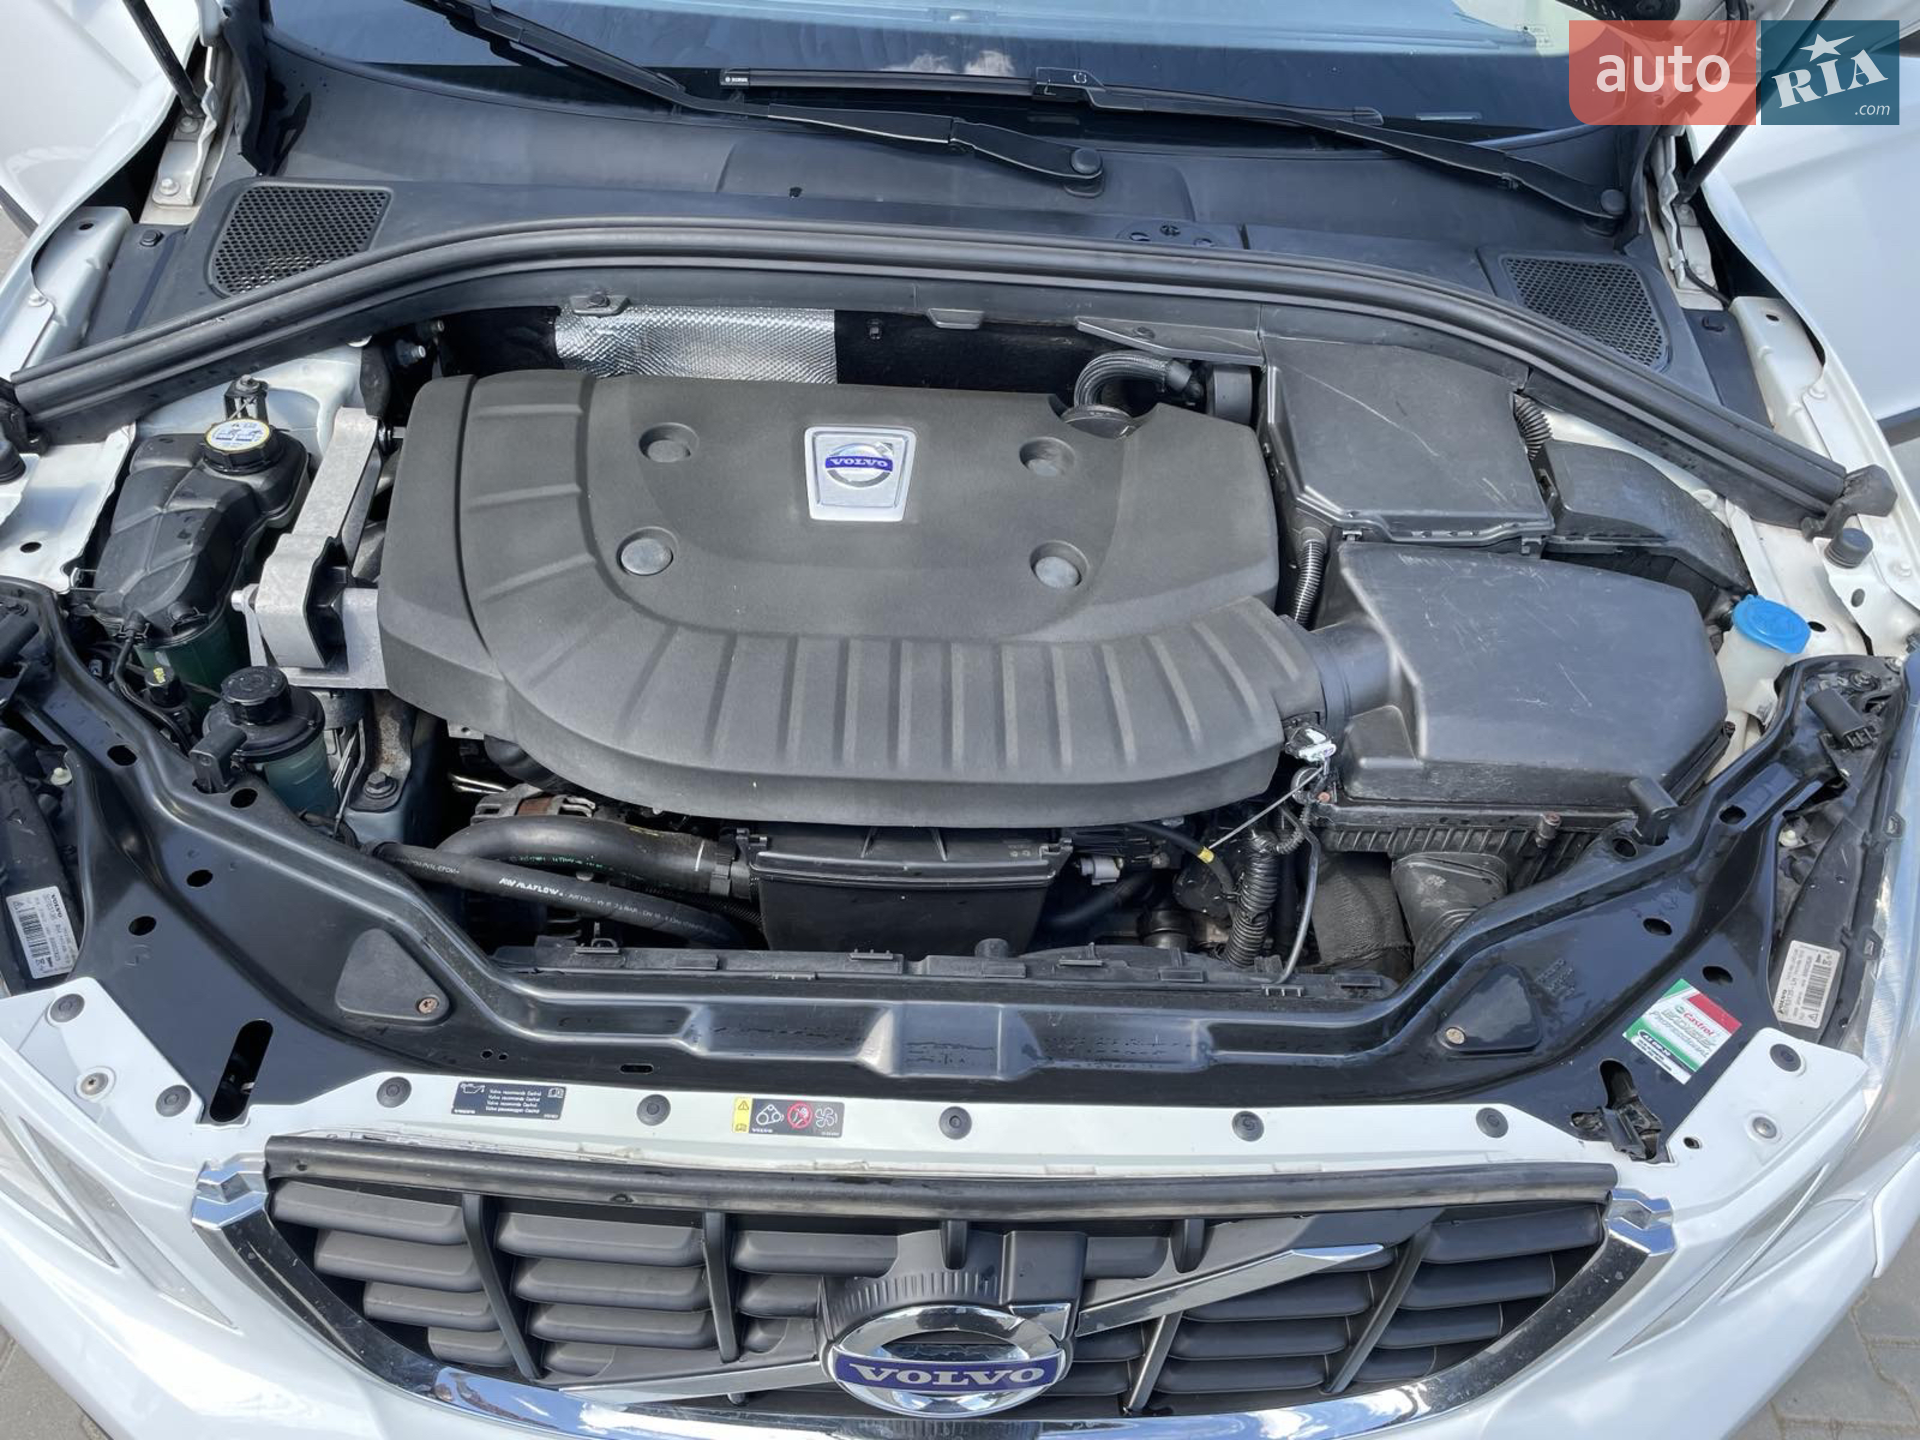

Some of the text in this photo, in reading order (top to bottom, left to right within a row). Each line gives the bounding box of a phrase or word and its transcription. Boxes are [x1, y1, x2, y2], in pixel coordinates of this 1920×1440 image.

[830, 458, 888, 466] VOLVO
[1683, 1011, 1715, 1037] Castrol
[849, 1363, 1045, 1386] VOLVO
